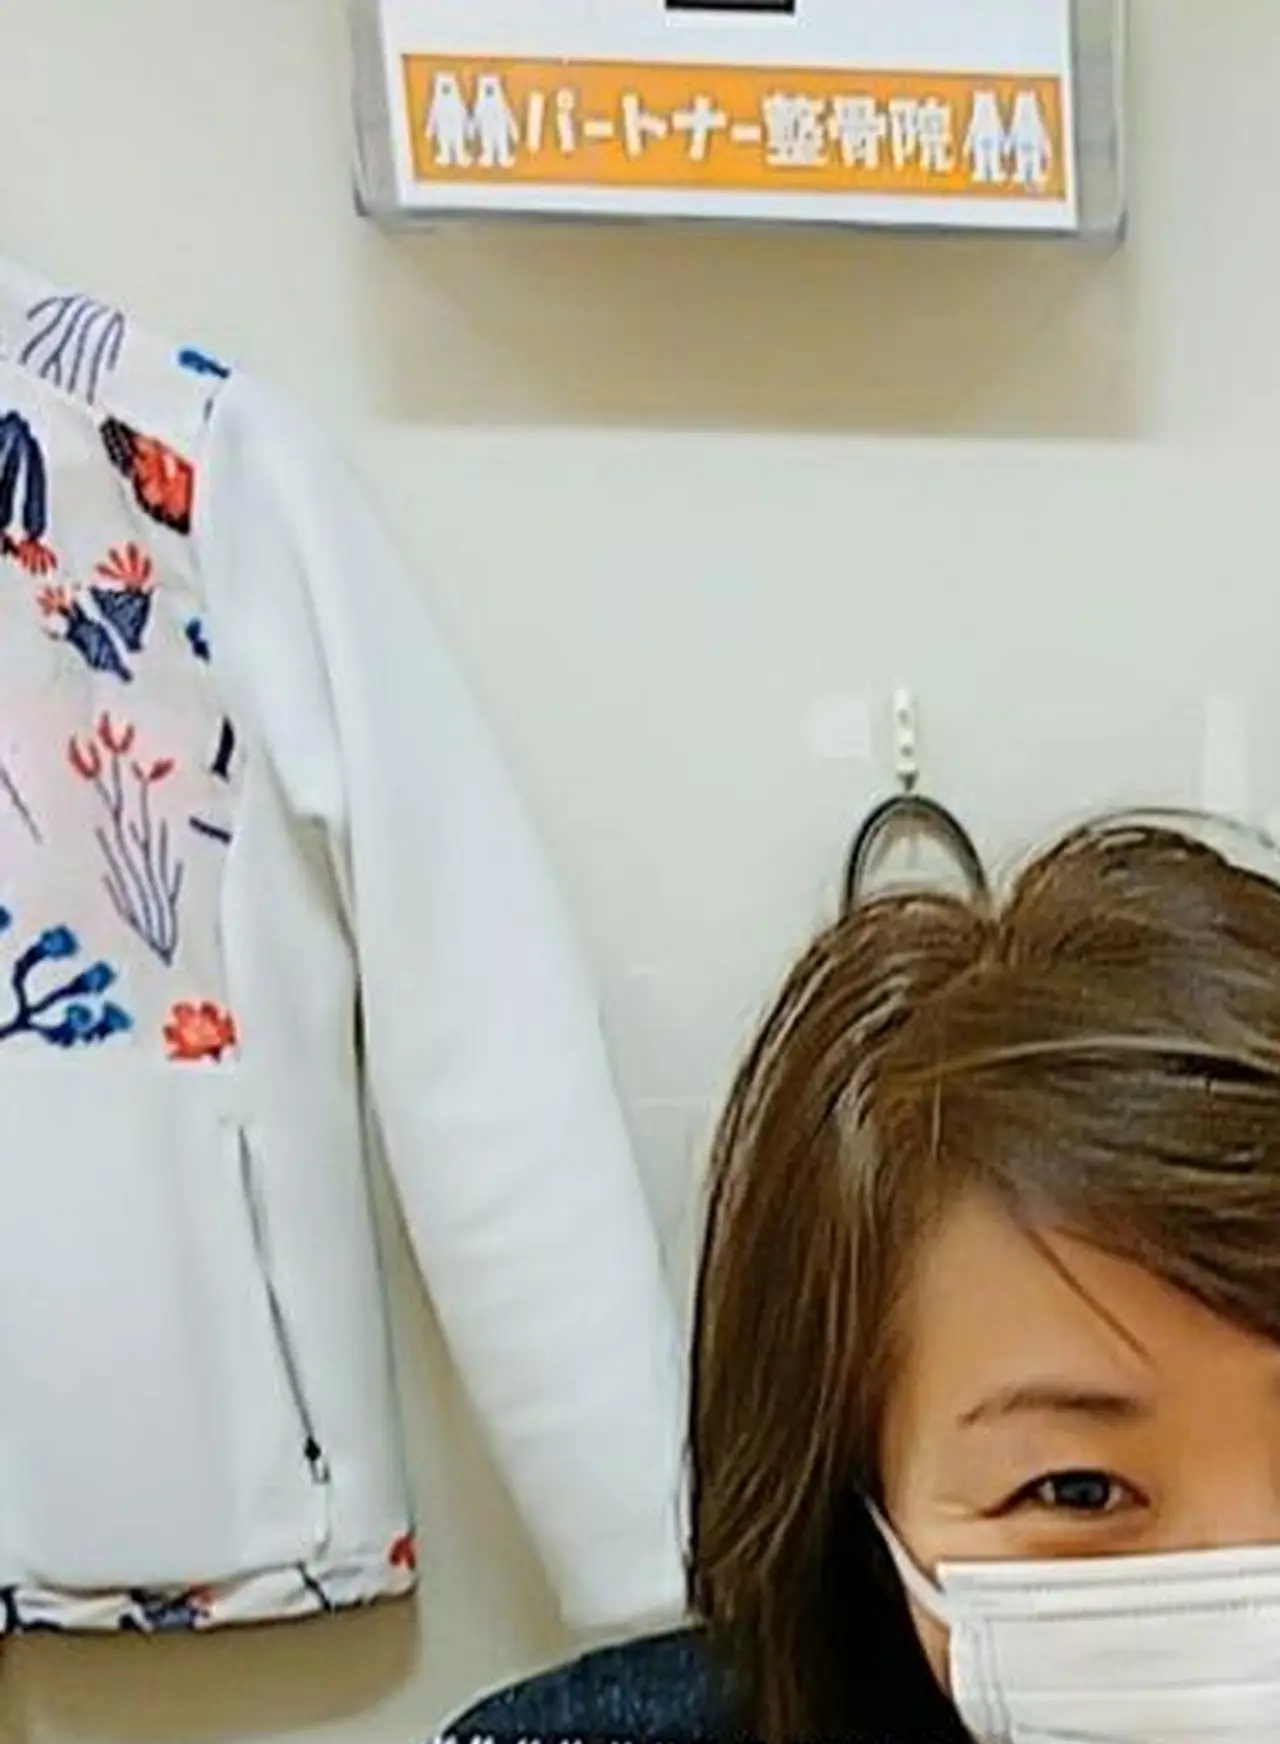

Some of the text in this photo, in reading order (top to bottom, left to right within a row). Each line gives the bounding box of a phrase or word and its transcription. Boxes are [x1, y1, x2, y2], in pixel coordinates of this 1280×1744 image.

[524, 88, 956, 174] パートナー整骨院
